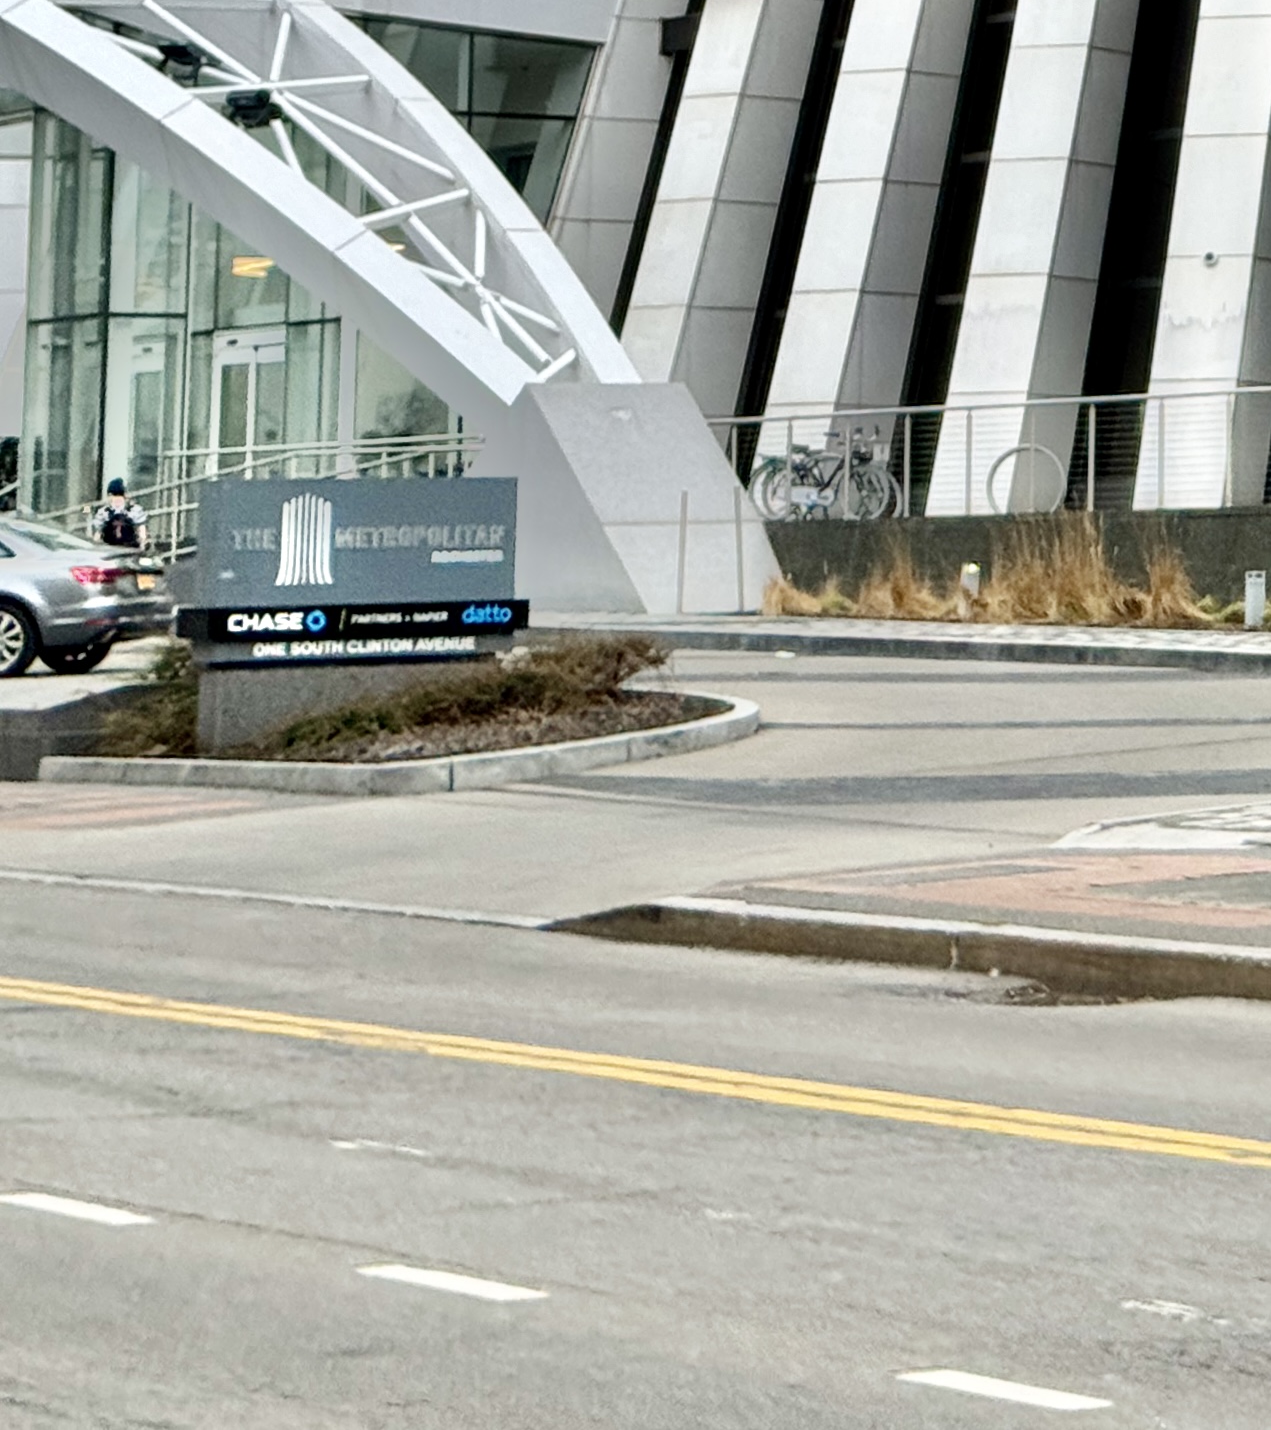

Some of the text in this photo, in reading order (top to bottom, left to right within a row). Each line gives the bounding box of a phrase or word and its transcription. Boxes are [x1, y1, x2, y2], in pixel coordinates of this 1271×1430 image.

[230, 524, 505, 551] THE METROPOLITAN
[227, 611, 304, 632] CHASE
[462, 603, 512, 624] datto
[252, 636, 475, 657] ONE SOUTH CLINTON AVENUE
